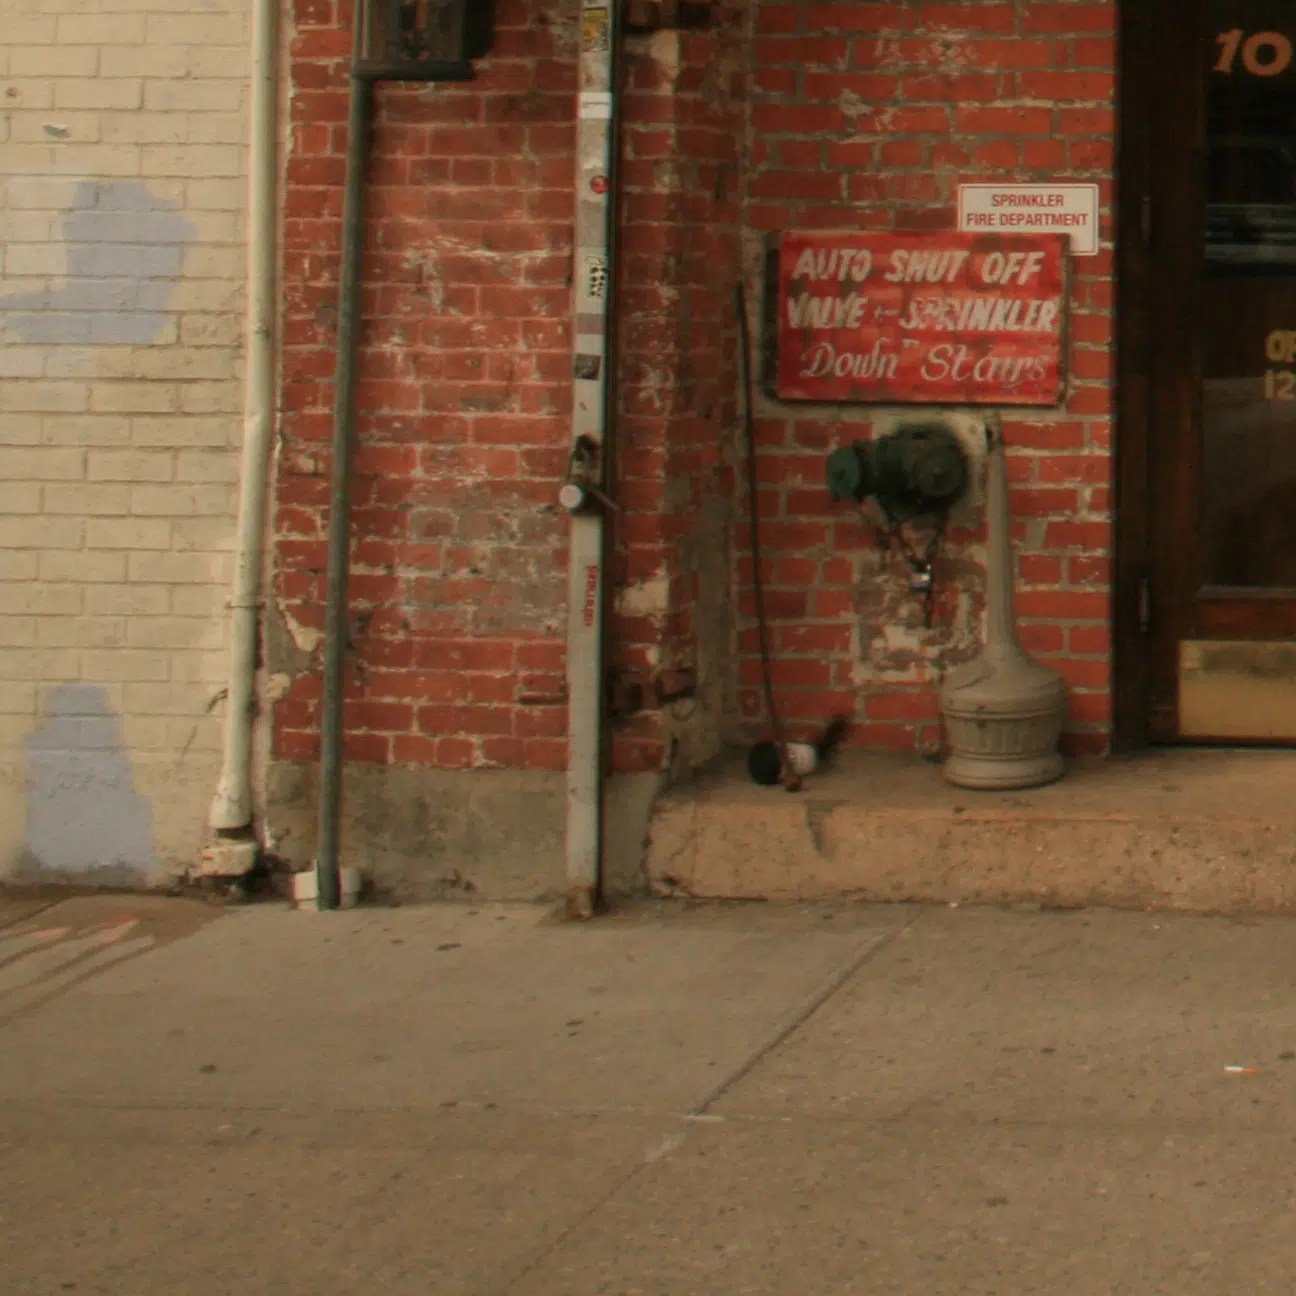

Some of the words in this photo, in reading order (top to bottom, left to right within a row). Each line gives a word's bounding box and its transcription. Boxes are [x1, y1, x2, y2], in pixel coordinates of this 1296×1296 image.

[1213, 29, 1292, 77] 10
[967, 212, 995, 226] FIRE
[1000, 212, 1088, 226] DEPARTMENT
[991, 194, 1064, 207] SPRINKLER
[791, 248, 873, 282] AUTO
[885, 249, 968, 282] SHUT
[982, 251, 1046, 284] OFF
[786, 291, 868, 329] VALVE
[900, 296, 1060, 332] SPRINKLER
[800, 338, 899, 381] Down
[921, 343, 1048, 389] Stairs
